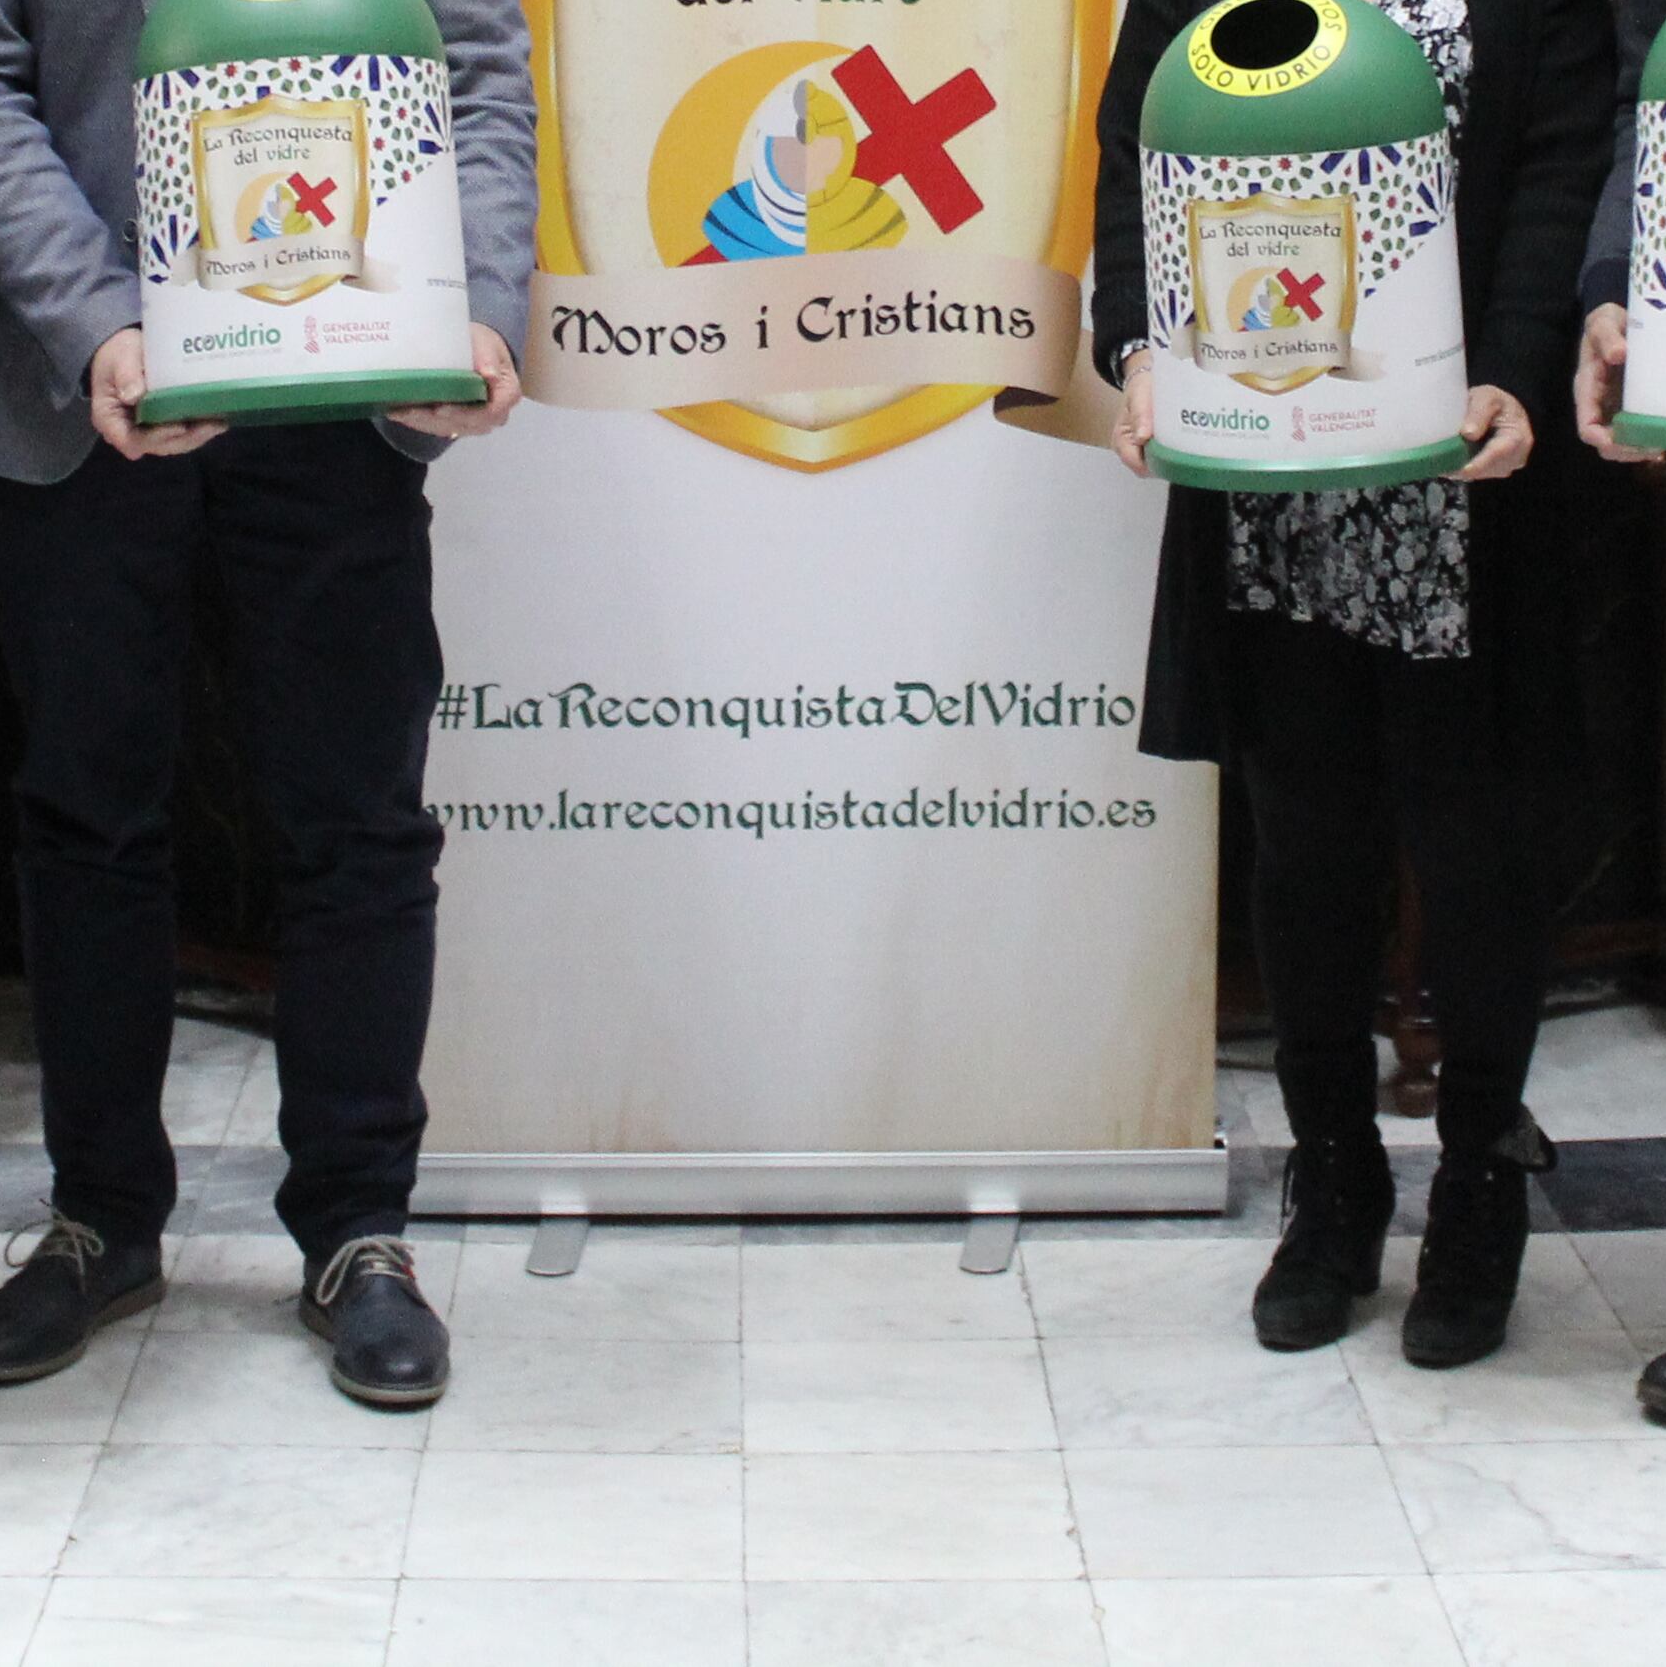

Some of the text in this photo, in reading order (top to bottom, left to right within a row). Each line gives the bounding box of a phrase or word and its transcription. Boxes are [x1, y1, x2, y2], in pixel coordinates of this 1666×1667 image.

[1192, 43, 1330, 91] SOLO VIDRIO
[230, 125, 353, 146] Reconquesta
[234, 145, 310, 166] del vidre
[1222, 221, 1341, 239] Reconquesta
[1227, 241, 1300, 257] del vidre
[206, 259, 256, 276] Moros
[276, 245, 351, 265] Cristians
[322, 321, 390, 333] GENERALITAT
[551, 290, 1035, 355] Moros i Cristians
[183, 322, 281, 354] ecovidrio
[323, 333, 390, 344] VALENCIANA
[1201, 343, 1247, 360] Moros
[1265, 339, 1338, 357] Cristians
[1181, 407, 1270, 430] ecovidrio
